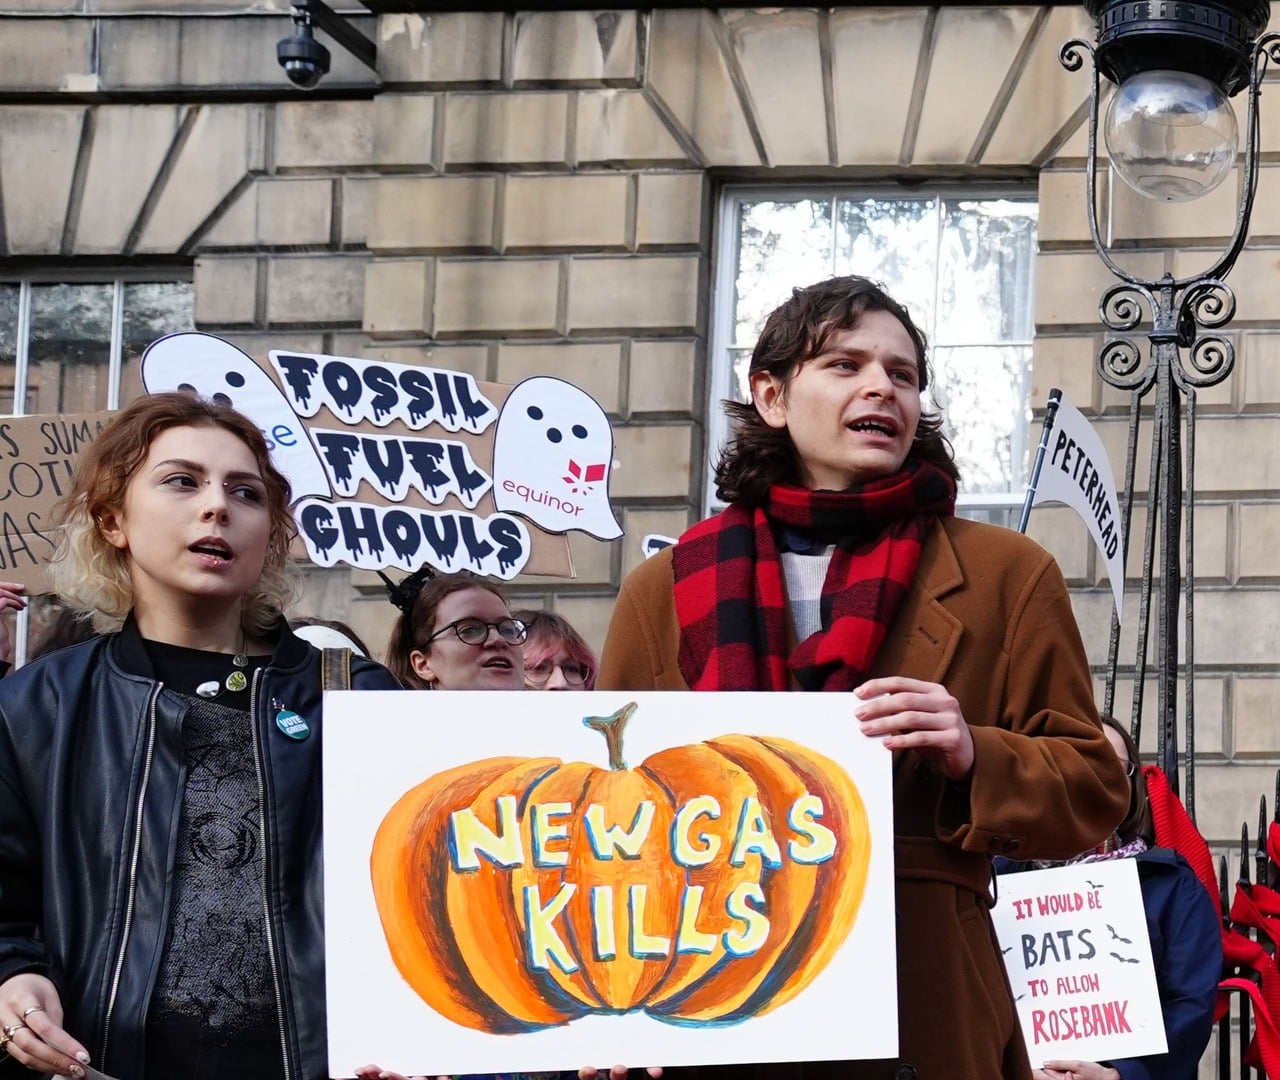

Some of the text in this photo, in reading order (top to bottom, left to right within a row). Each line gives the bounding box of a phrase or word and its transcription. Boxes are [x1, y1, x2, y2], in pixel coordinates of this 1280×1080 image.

[277, 354, 490, 429] FOSSIL
[316, 432, 487, 503] FUEL
[1051, 429, 1118, 561] PETERHEAD
[502, 478, 585, 517] equinor
[301, 504, 523, 576] GHOULS
[279, 715, 304, 728] VOTE
[448, 793, 838, 873] NEW GAS
[522, 881, 772, 975] KILLS
[1012, 890, 1103, 921] IT WOULD BE
[1021, 928, 1097, 970] BATS
[1027, 973, 1100, 998] TO ALLOW
[1031, 1000, 1133, 1045] ROSEBANK
